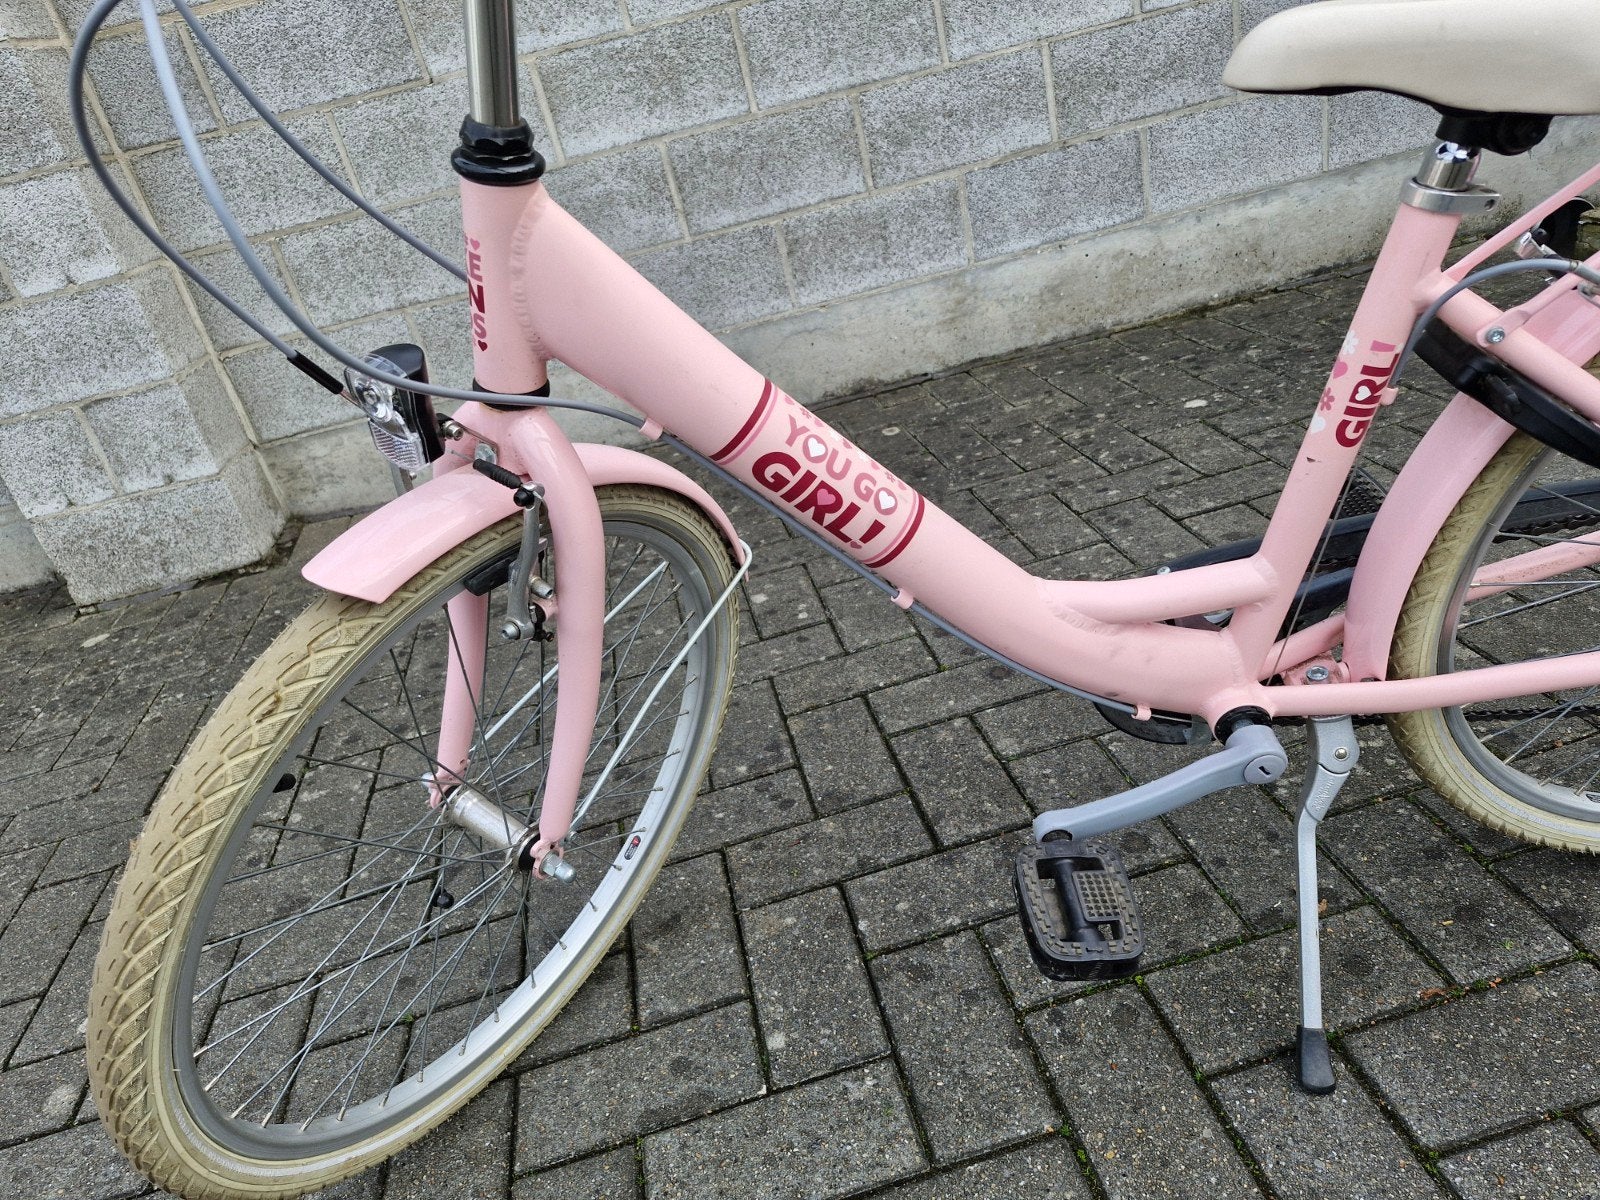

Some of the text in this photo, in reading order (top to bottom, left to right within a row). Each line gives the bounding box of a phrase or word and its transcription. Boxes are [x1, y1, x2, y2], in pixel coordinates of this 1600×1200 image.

[751, 451, 886, 549] GIRL!
[785, 414, 898, 516] YOU GO
